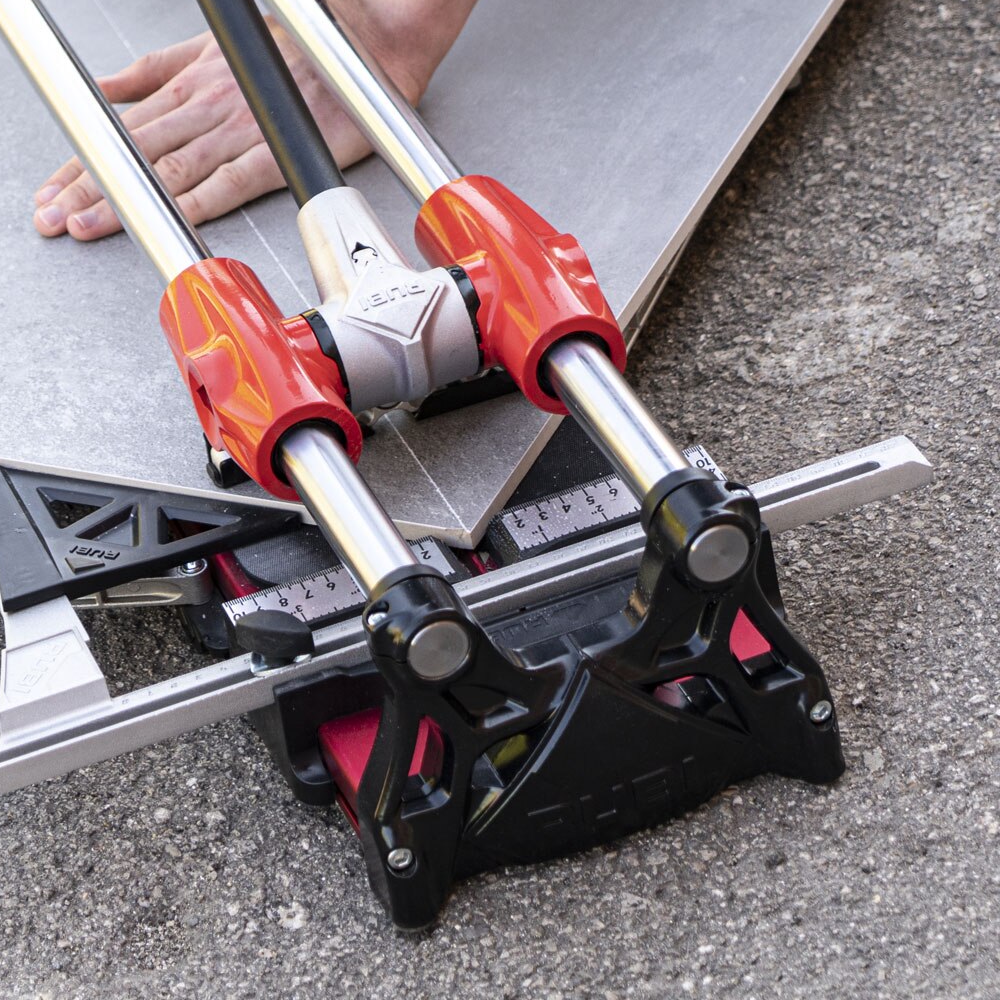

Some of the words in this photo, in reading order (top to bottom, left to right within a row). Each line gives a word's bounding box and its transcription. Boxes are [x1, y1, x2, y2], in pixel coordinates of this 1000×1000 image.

[359, 280, 426, 312] RUBI
[696, 458, 711, 468] 10
[515, 519, 525, 528] 2
[539, 511, 549, 520] 3
[562, 504, 571, 513] 4
[585, 495, 595, 505] 5
[609, 488, 618, 497] 6
[69, 545, 120, 560] RUBI
[420, 550, 431, 560] 2
[327, 582, 336, 591] 6
[305, 590, 314, 599] 7
[279, 598, 289, 607] 8
